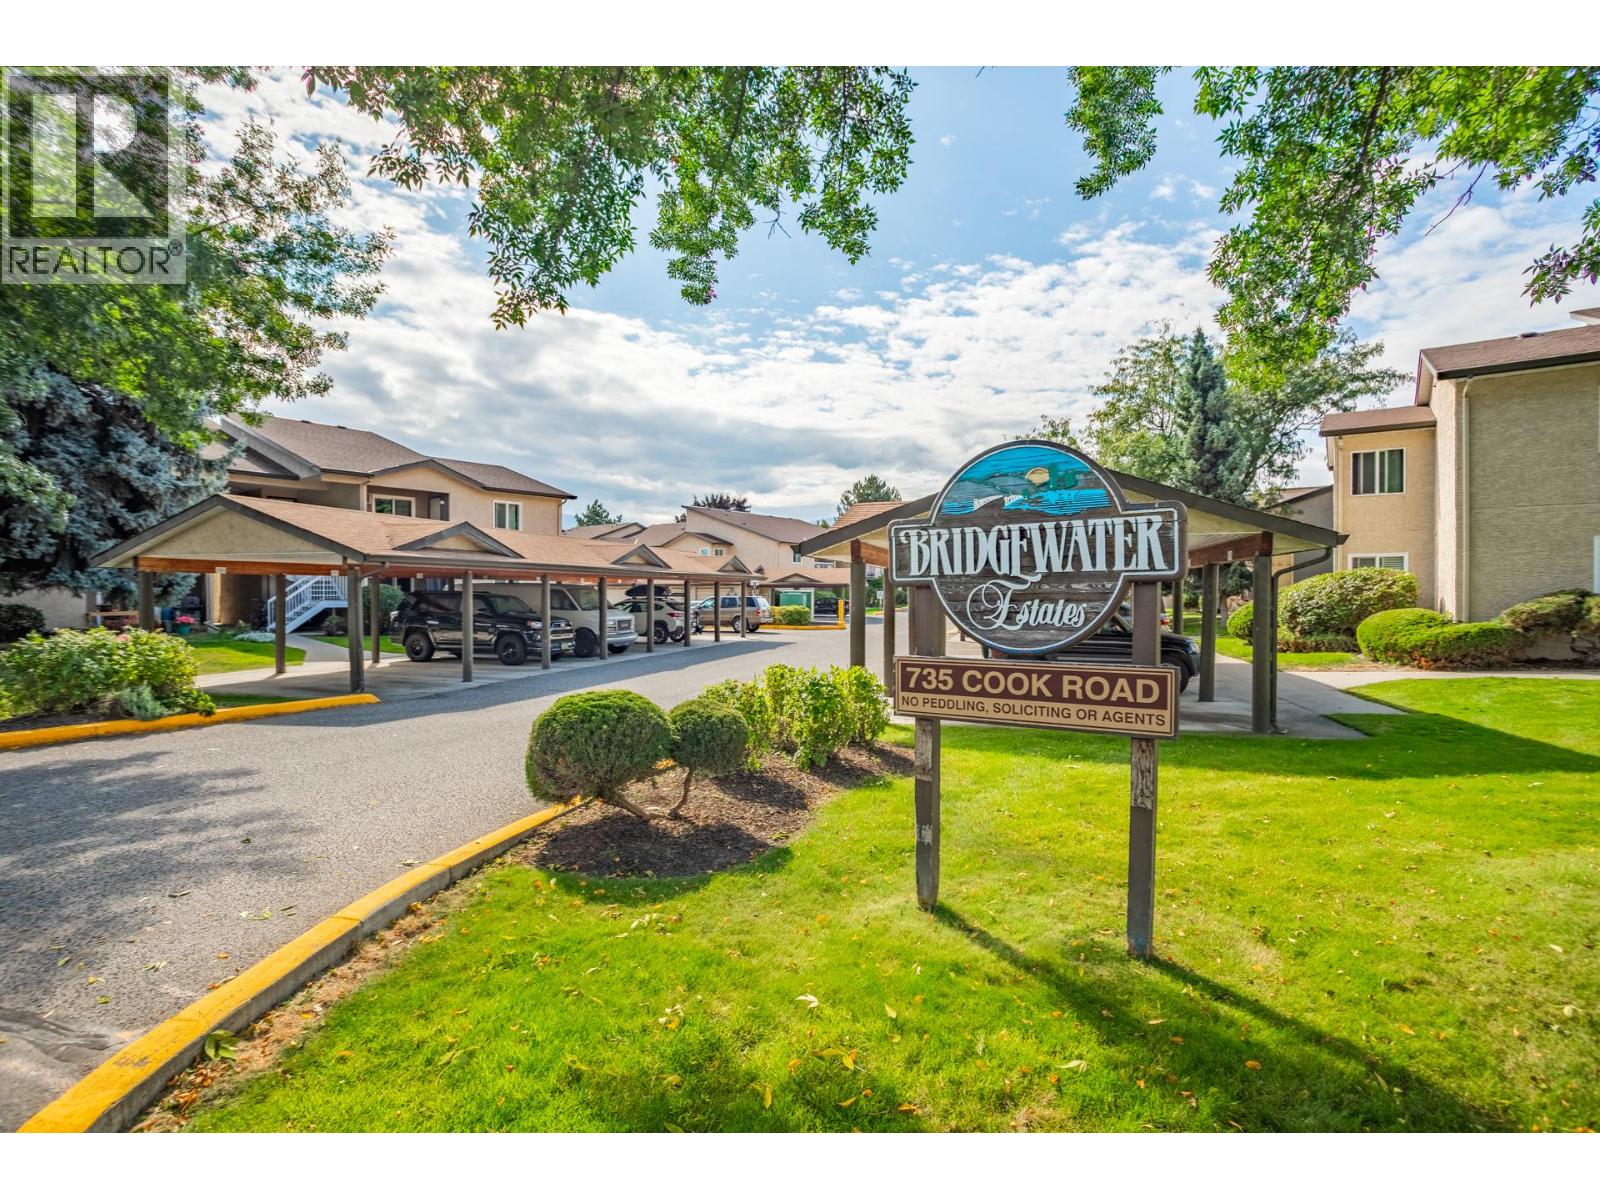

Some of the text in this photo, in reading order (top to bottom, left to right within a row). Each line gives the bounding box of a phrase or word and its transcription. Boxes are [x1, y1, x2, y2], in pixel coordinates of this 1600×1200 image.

[900, 514, 1168, 583] BRIDGEWATER
[966, 580, 1088, 631] Estates
[906, 667, 1160, 704] 735 COOK ROAD
[902, 696, 919, 707] NO
[993, 703, 1072, 719] SOLICITING
[1076, 708, 1097, 721] OR
[1101, 711, 1166, 726] AGENTS
